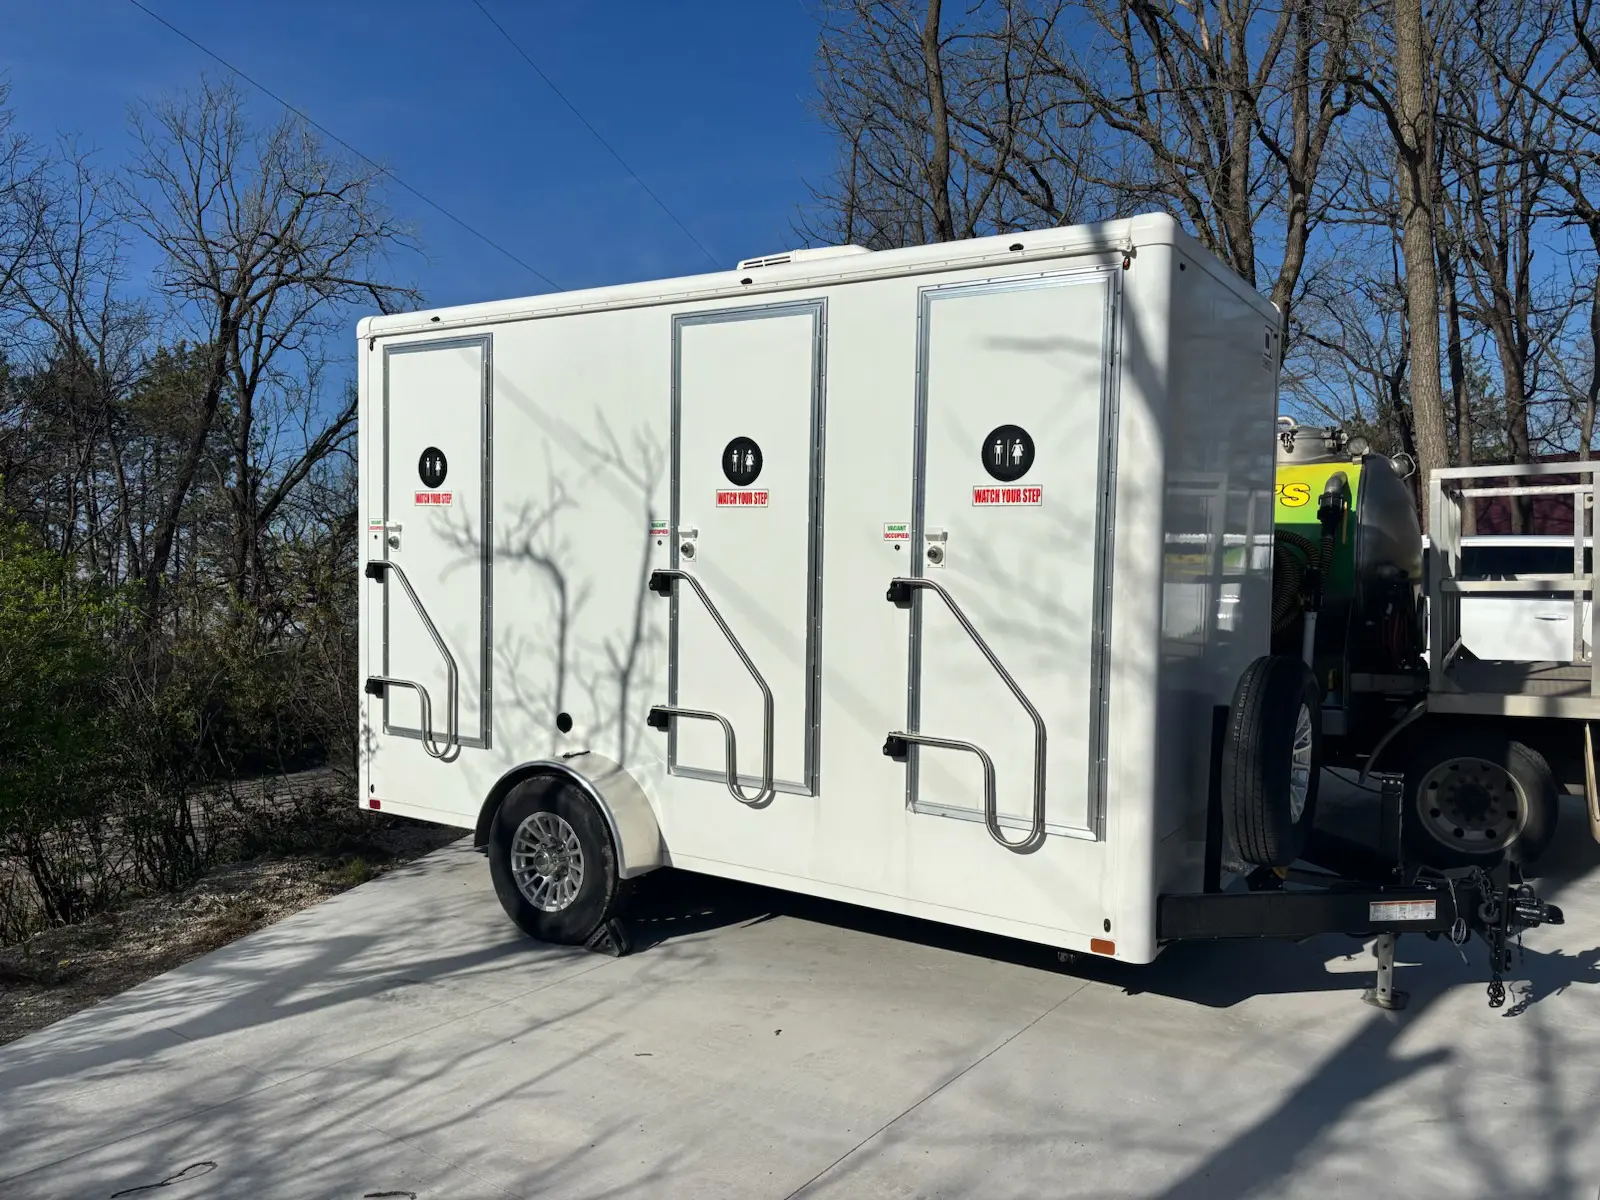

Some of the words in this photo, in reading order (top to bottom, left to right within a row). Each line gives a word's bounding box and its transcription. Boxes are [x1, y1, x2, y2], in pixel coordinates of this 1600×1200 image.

[717, 492, 737, 505] WATCH
[738, 492, 753, 505] YOUR
[754, 492, 768, 505] STEP
[974, 489, 1000, 503] WATCH
[1001, 489, 1021, 503] YOUR
[1022, 488, 1041, 502] STEP
